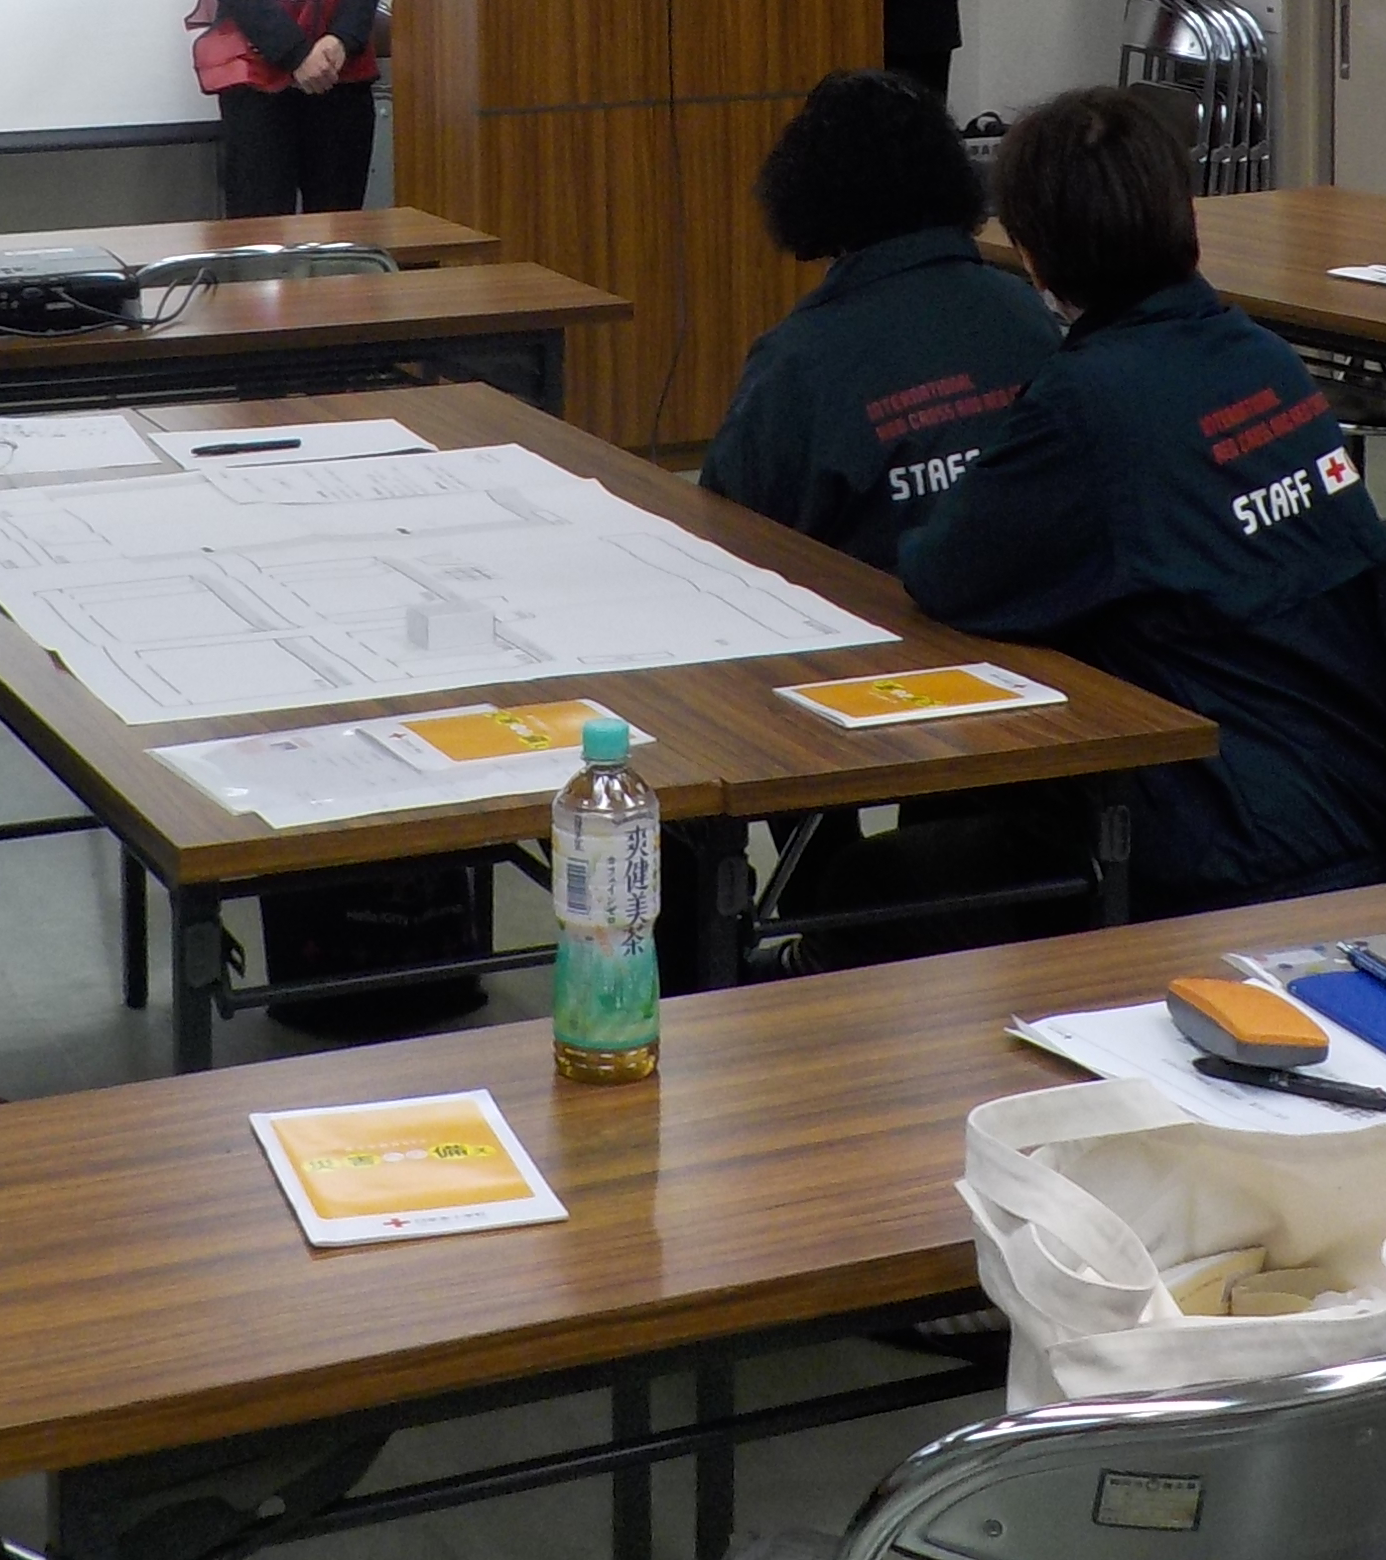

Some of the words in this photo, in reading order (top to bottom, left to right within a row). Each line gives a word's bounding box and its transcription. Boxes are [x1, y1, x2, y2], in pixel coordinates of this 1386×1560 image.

[1232, 468, 1313, 536] STAFF
[606, 856, 617, 924] カフェインゼロ
[621, 824, 650, 956] 爽健美茶
